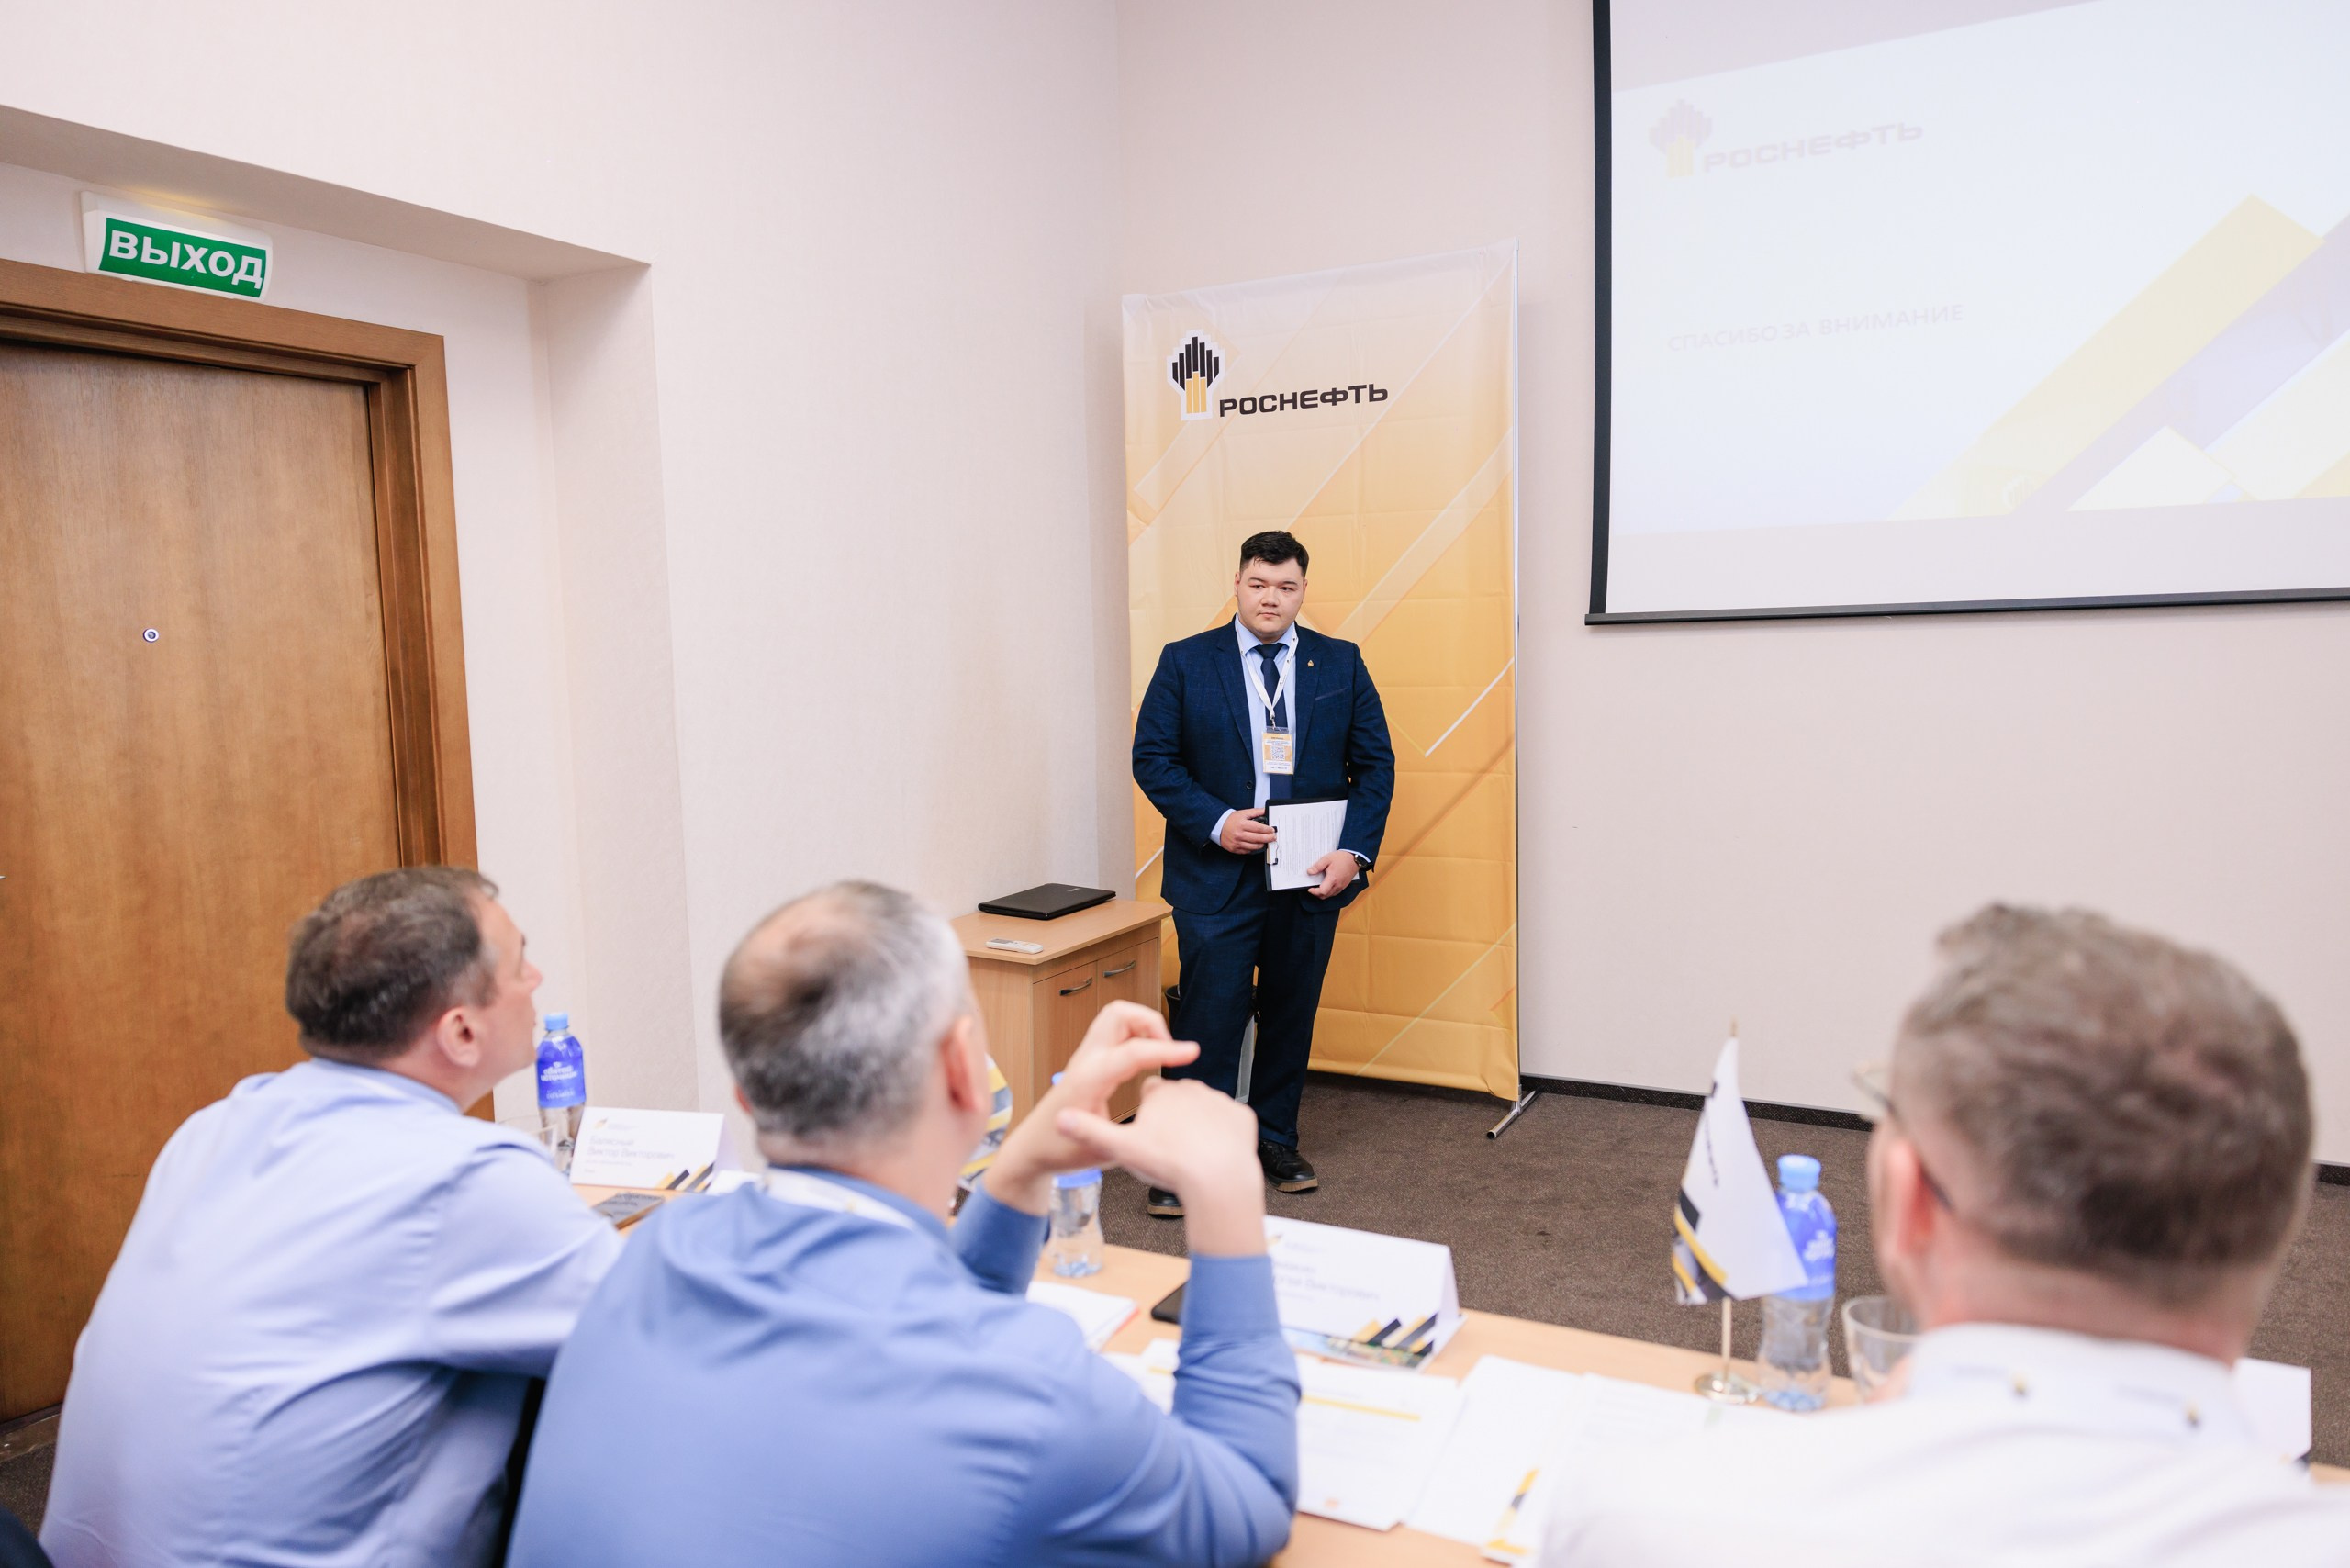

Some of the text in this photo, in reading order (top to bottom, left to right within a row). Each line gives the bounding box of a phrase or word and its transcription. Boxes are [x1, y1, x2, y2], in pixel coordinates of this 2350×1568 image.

[1702, 120, 1924, 173] РОСНЕФТЬ
[108, 229, 263, 289] ВЫХОД
[1667, 304, 1964, 353] СПАСИБО ЗА ВНИМАНИЕ
[1219, 383, 1389, 418] РОСНЕФТЬ
